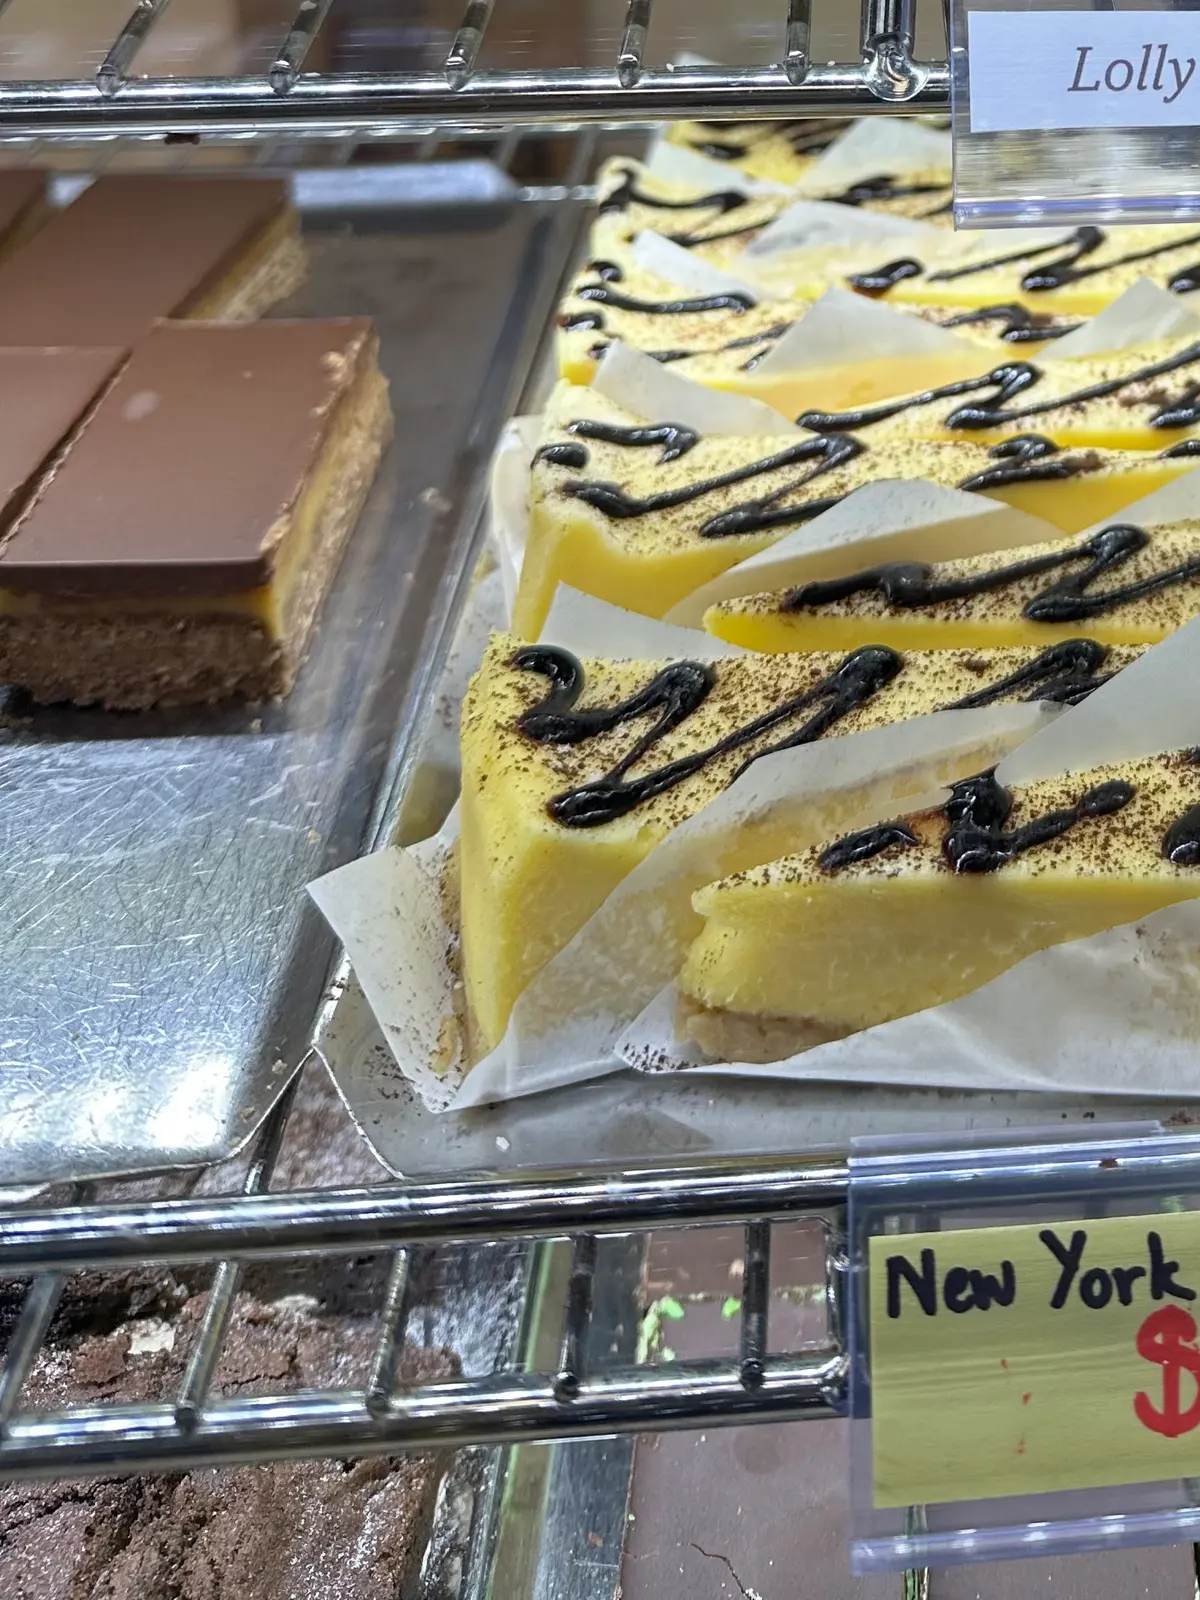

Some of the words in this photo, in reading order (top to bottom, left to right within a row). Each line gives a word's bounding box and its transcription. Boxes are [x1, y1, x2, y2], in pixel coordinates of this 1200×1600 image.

[1066, 43, 1197, 104] Lolly
[885, 1248, 1016, 1320] New
[1039, 1229, 1198, 1311] York
